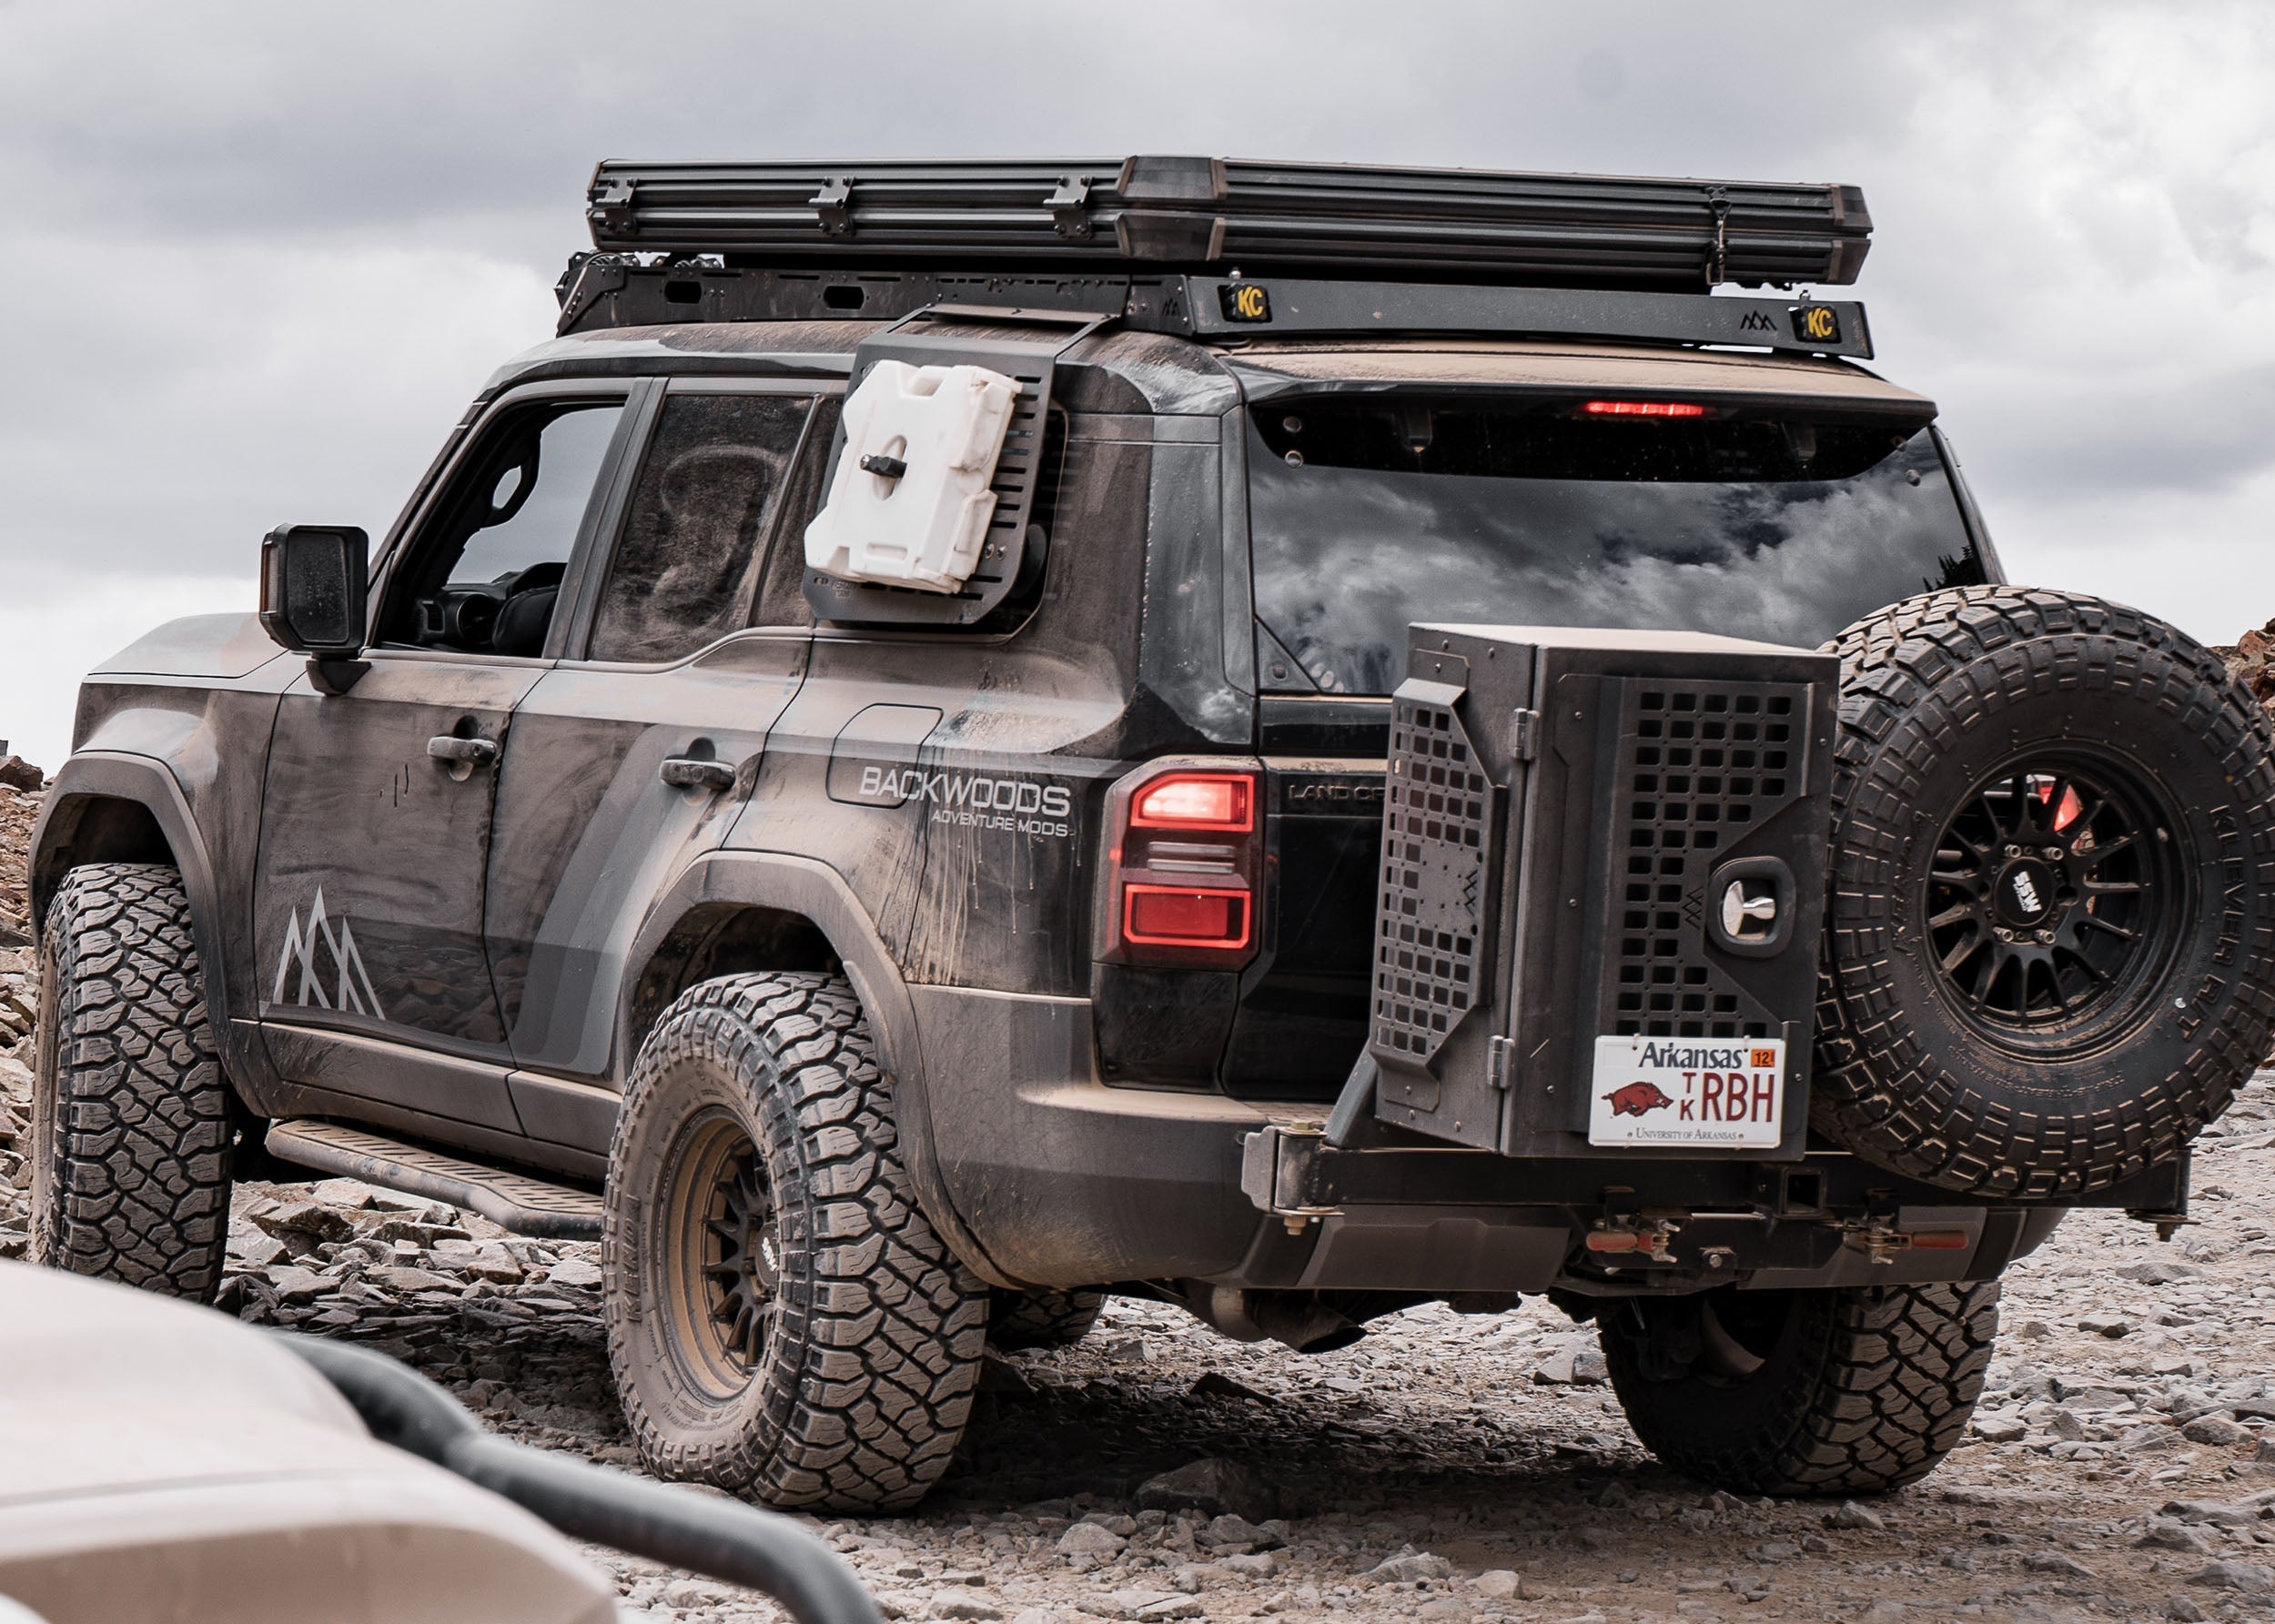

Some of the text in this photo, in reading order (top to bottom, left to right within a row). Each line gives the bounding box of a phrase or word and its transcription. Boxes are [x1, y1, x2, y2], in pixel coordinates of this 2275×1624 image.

[1238, 286, 1264, 318] KC
[1807, 308, 1834, 338] KC
[858, 765, 1072, 817] BACKWOODS
[1289, 784, 1350, 801] LAND
[931, 809, 1069, 838] ADVENTURE MODS
[2178, 804, 2247, 1042] KLEVER R/T
[1638, 1041, 1744, 1069] Arkansas
[1755, 1051, 1770, 1064] 12
